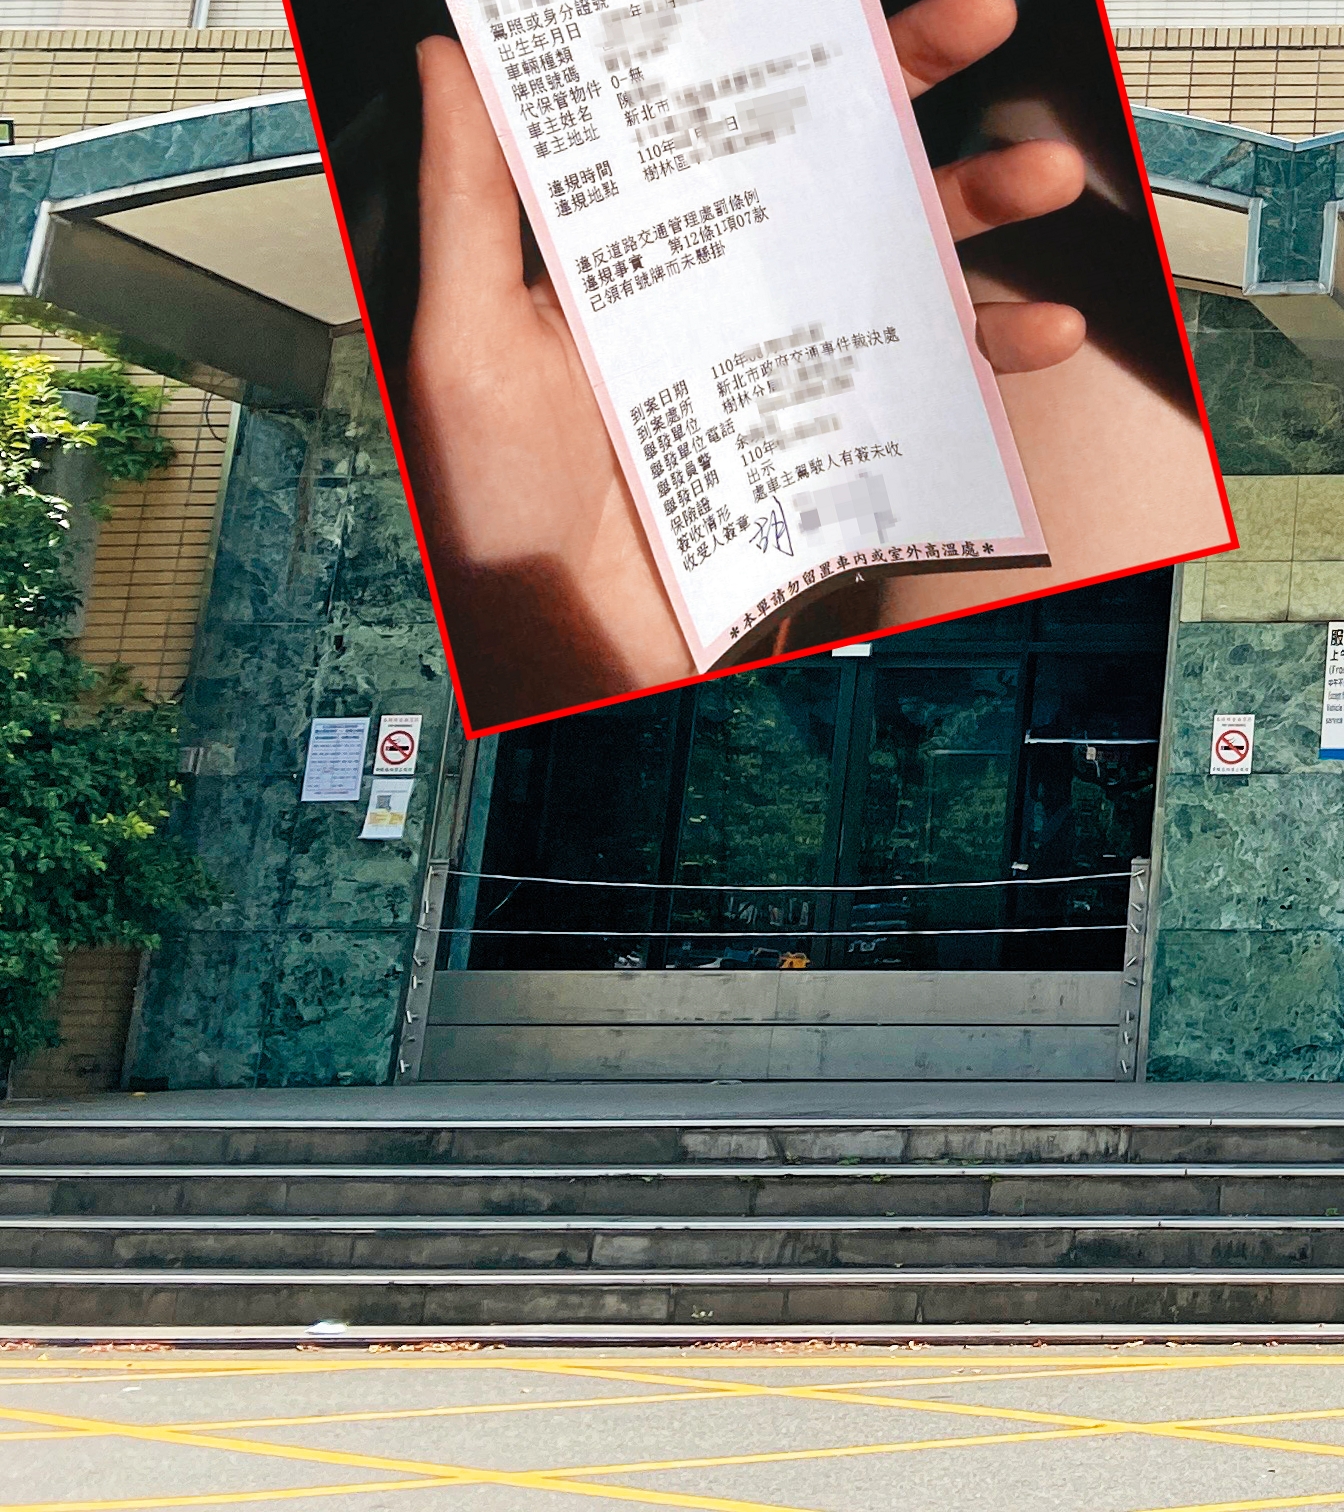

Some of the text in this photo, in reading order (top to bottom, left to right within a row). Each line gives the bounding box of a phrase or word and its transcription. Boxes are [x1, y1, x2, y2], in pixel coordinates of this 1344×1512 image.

[498, 22, 582, 63] 出生年月日
[504, 45, 575, 82] 車輛種類
[511, 65, 581, 103] 牌照號碼
[519, 79, 603, 121] 代保管物件
[527, 105, 593, 140] 車主姓名
[534, 126, 600, 160] 車主地址
[547, 160, 614, 199] 違規時間
[555, 179, 620, 218] 違規地點
[575, 188, 761, 276] 違反道路交通管理處罰條例
[581, 254, 644, 294] 違規事實
[589, 239, 726, 313] 已領有號牌而未懸掛
[630, 380, 689, 426] 到案日期
[636, 399, 693, 445] 到案處所
[643, 418, 701, 463] 舉發單位
[650, 418, 736, 481] 舉發單位電話
[746, 458, 776, 486] 出示
[663, 469, 720, 518] 舉發日期
